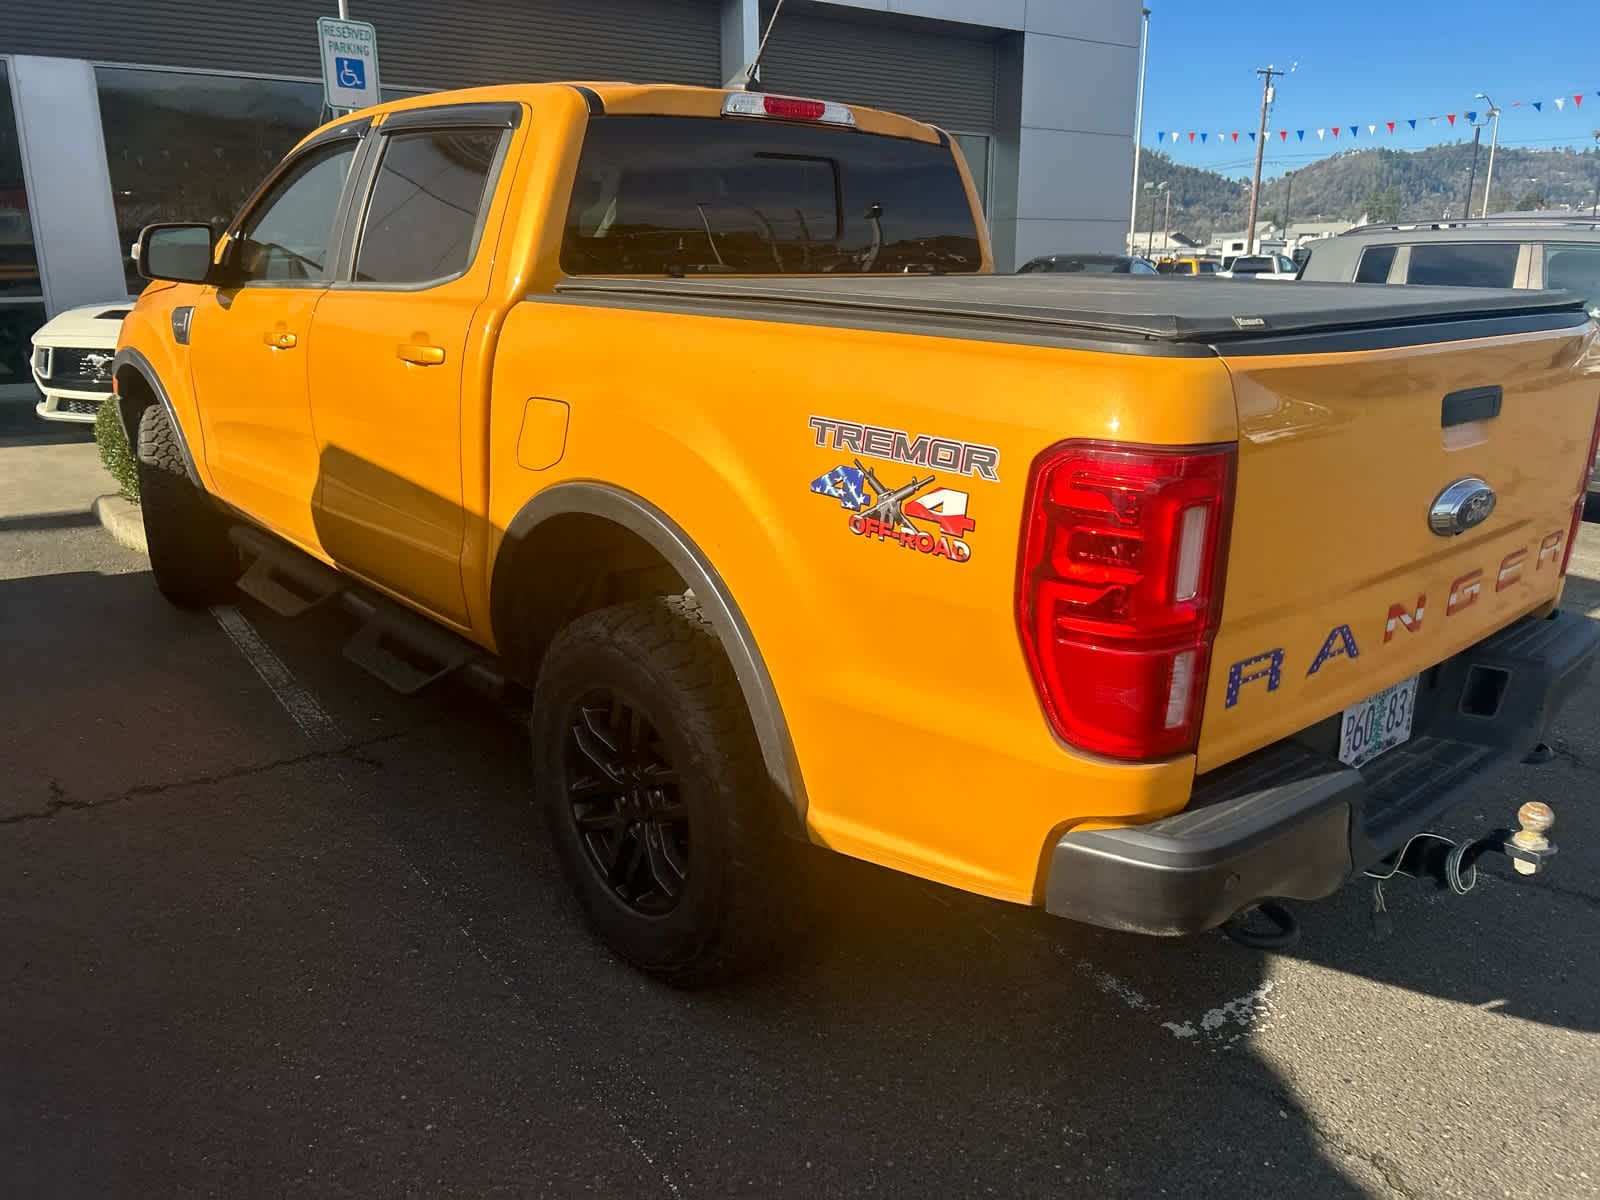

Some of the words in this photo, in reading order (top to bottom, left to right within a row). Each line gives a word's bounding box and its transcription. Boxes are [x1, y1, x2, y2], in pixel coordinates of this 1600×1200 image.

[323, 25, 372, 41] RESERVED
[328, 41, 370, 57] PARKING
[808, 415, 1000, 482] TREMOR
[849, 514, 972, 563] OFF-ROAD
[1224, 529, 1565, 710] RANGER
